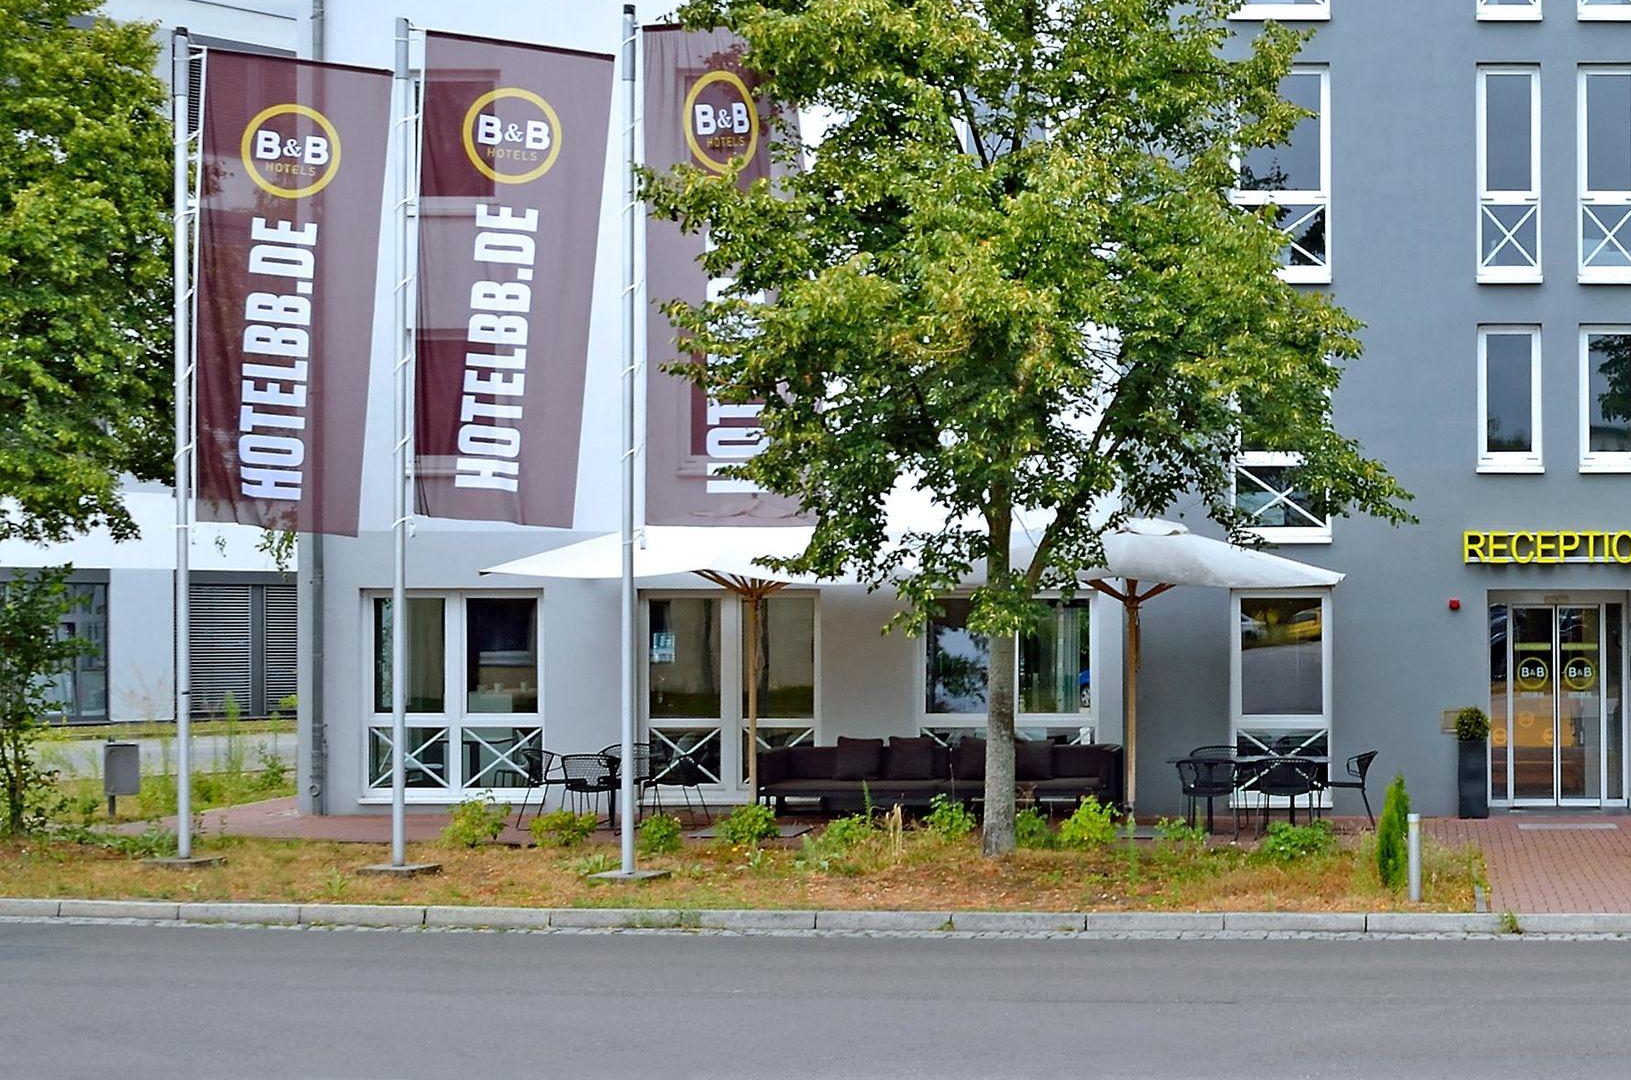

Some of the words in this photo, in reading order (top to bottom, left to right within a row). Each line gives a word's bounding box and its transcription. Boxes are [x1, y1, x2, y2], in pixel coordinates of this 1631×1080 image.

[478, 114, 550, 150] B&B
[695, 103, 750, 135] B&B
[256, 130, 329, 165] B&B
[486, 147, 538, 161] HOTELS
[707, 136, 745, 148] HOTELS
[265, 162, 317, 176] HOTELS
[238, 217, 318, 500] HOTELBB.DE
[455, 204, 539, 492] HOTELBB.DE
